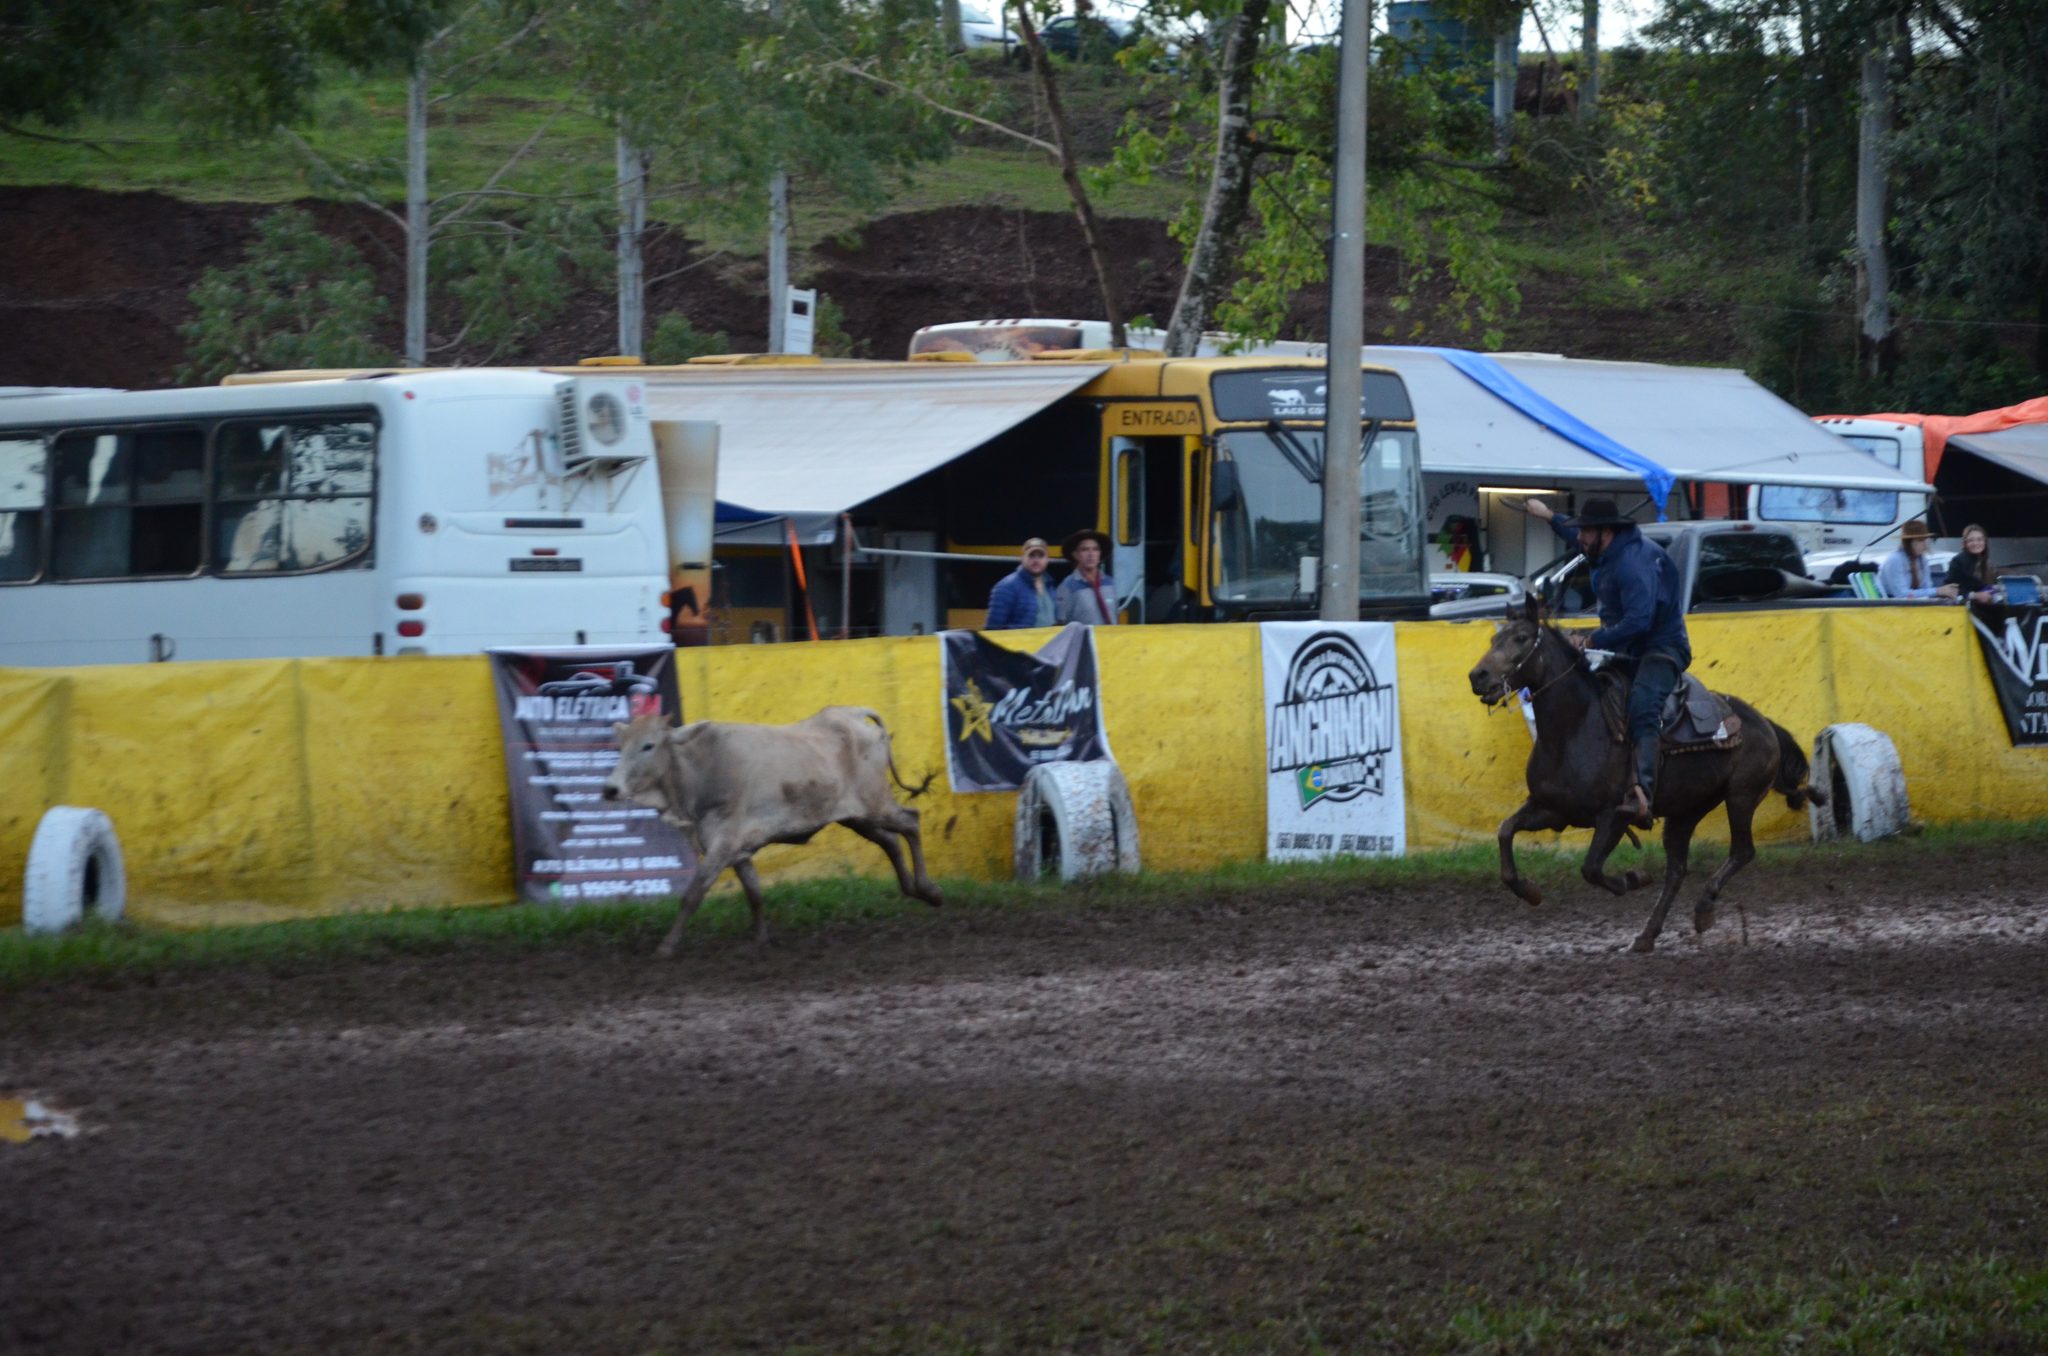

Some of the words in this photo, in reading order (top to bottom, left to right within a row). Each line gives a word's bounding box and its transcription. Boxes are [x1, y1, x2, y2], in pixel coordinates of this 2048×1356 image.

[1122, 410, 1198, 425] ENTRADA
[555, 692, 629, 720] ELÉTRICA
[1272, 688, 1392, 771] ANGHINONI
